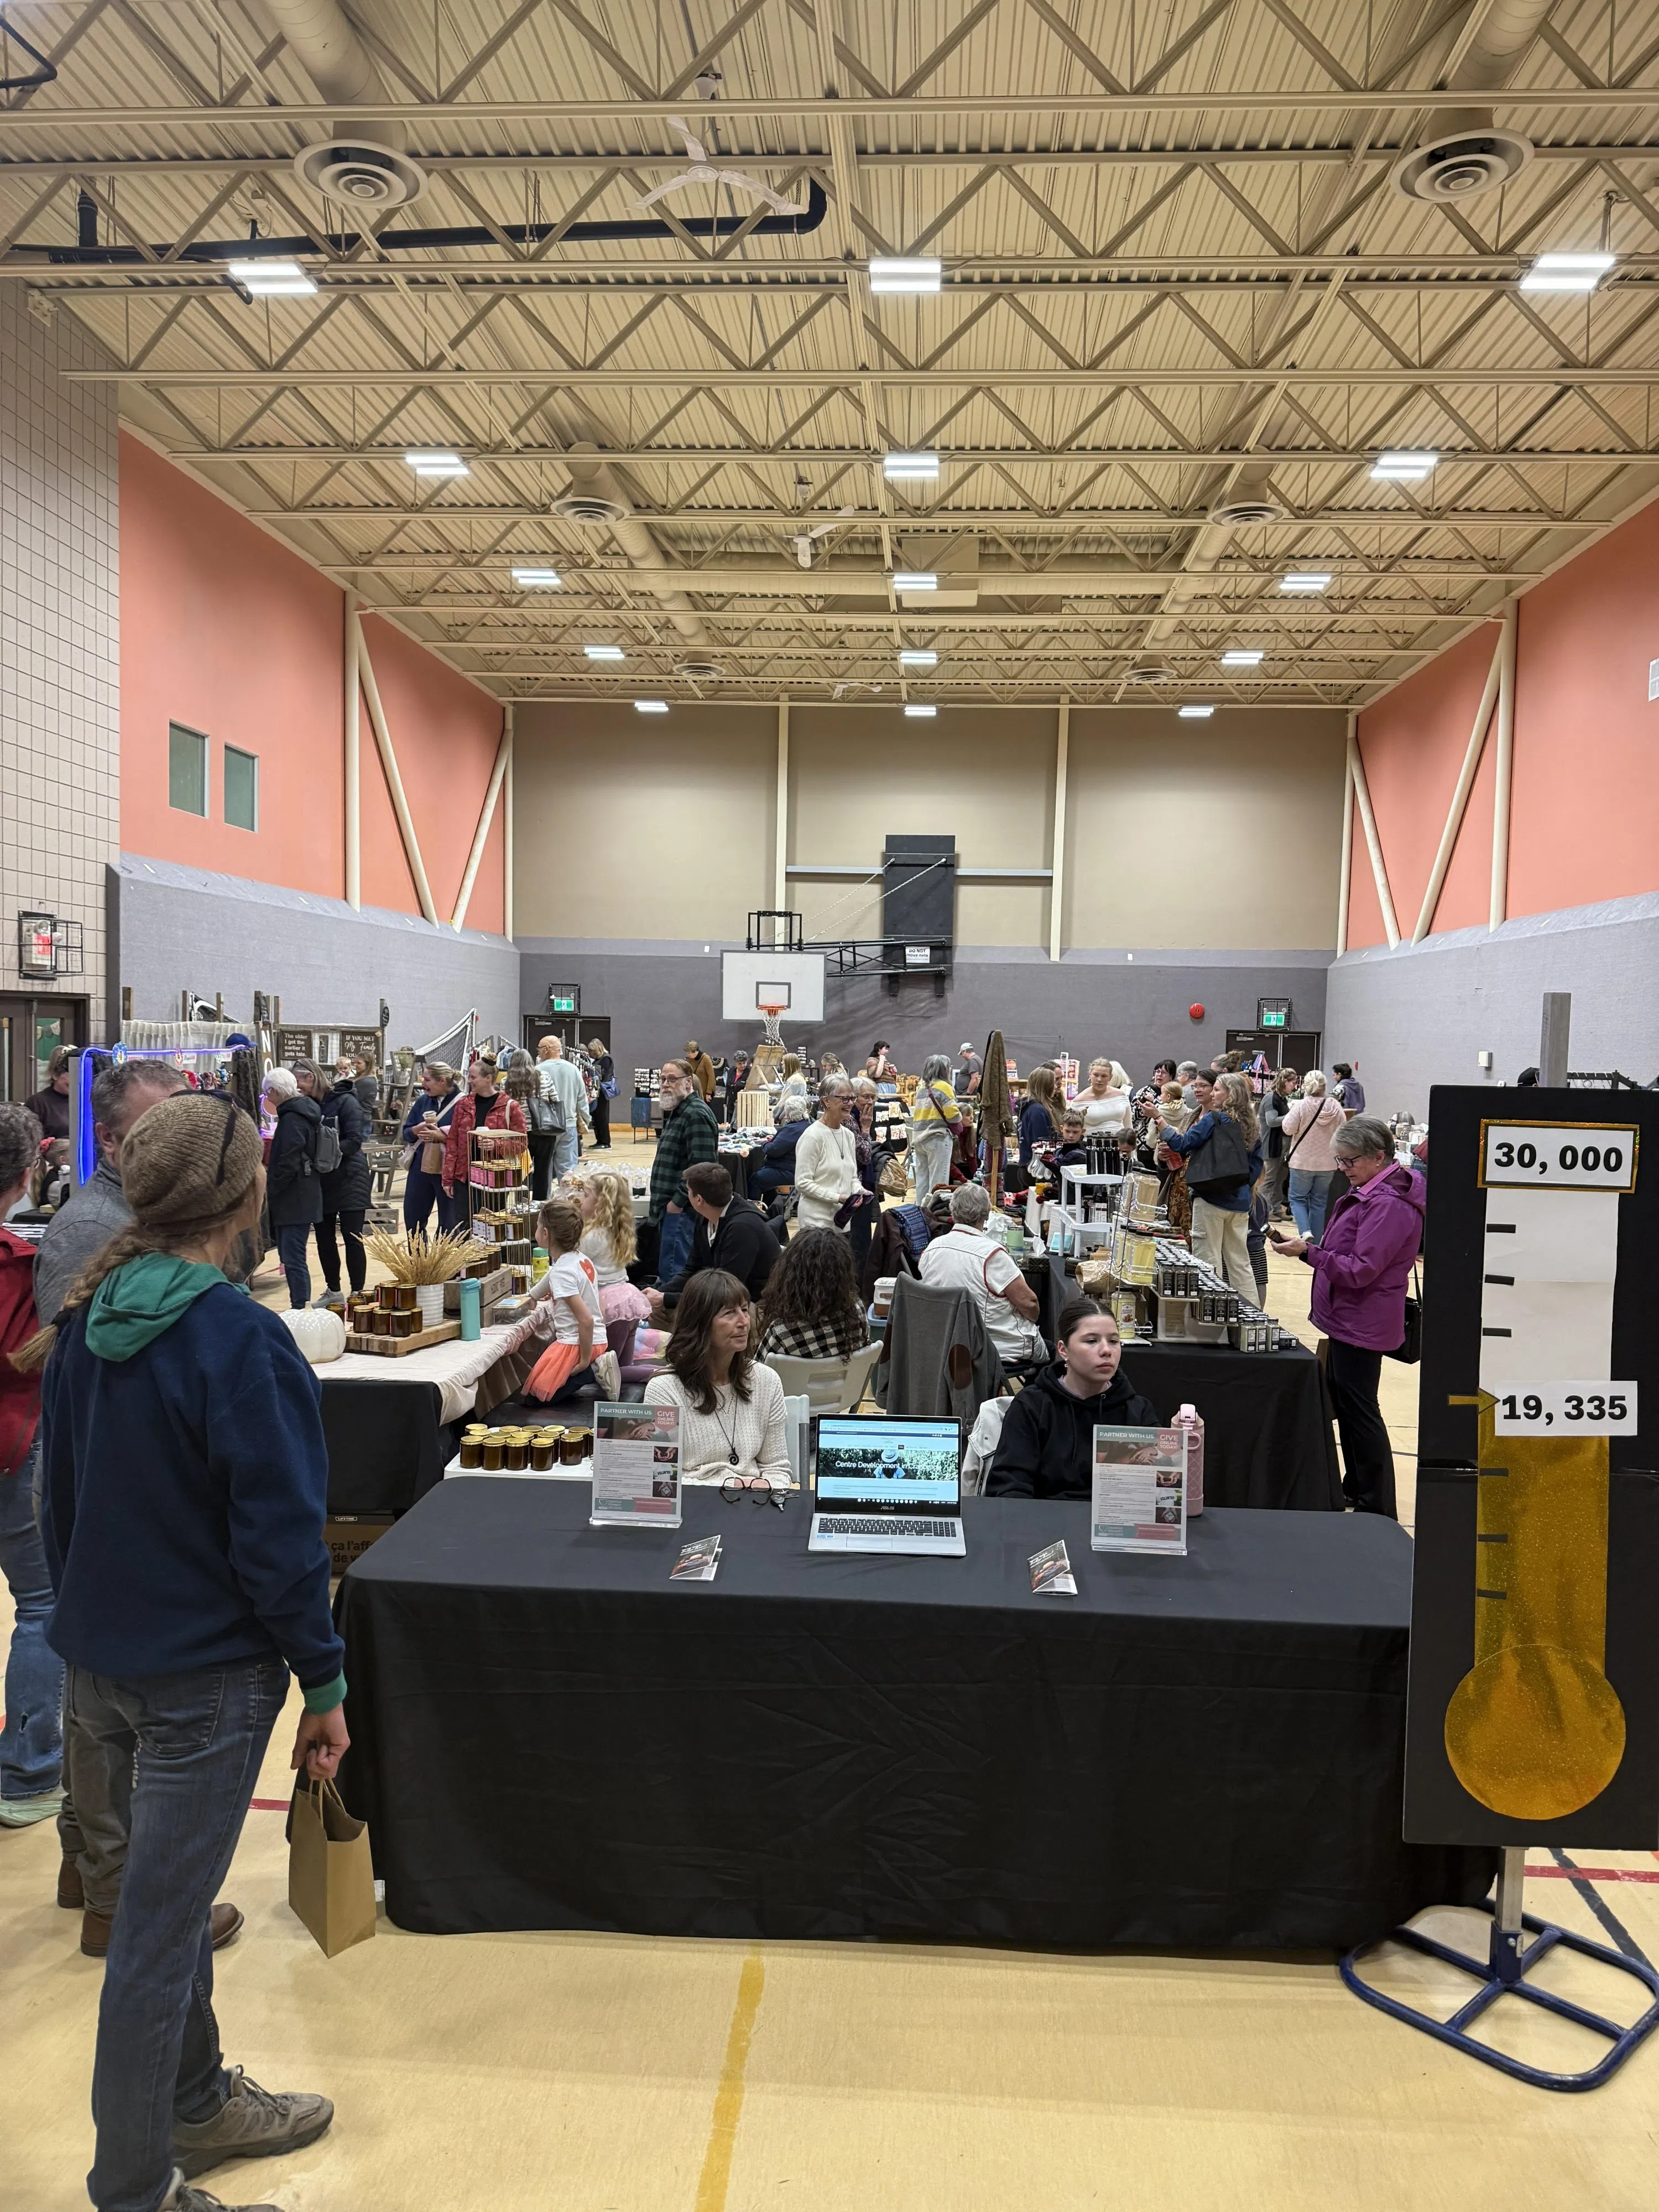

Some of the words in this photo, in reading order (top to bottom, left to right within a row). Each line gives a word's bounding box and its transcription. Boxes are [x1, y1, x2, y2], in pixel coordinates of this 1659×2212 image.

[345, 1041, 356, 1052] My
[359, 1041, 376, 1053] Family
[1494, 1142, 1548, 1175] 30,
[1558, 1145, 1623, 1172] 000
[1501, 1394, 1554, 1426] 19,
[1564, 1394, 1627, 1421] 335
[331, 1542, 344, 1552] ça
[333, 1553, 347, 1562] de
